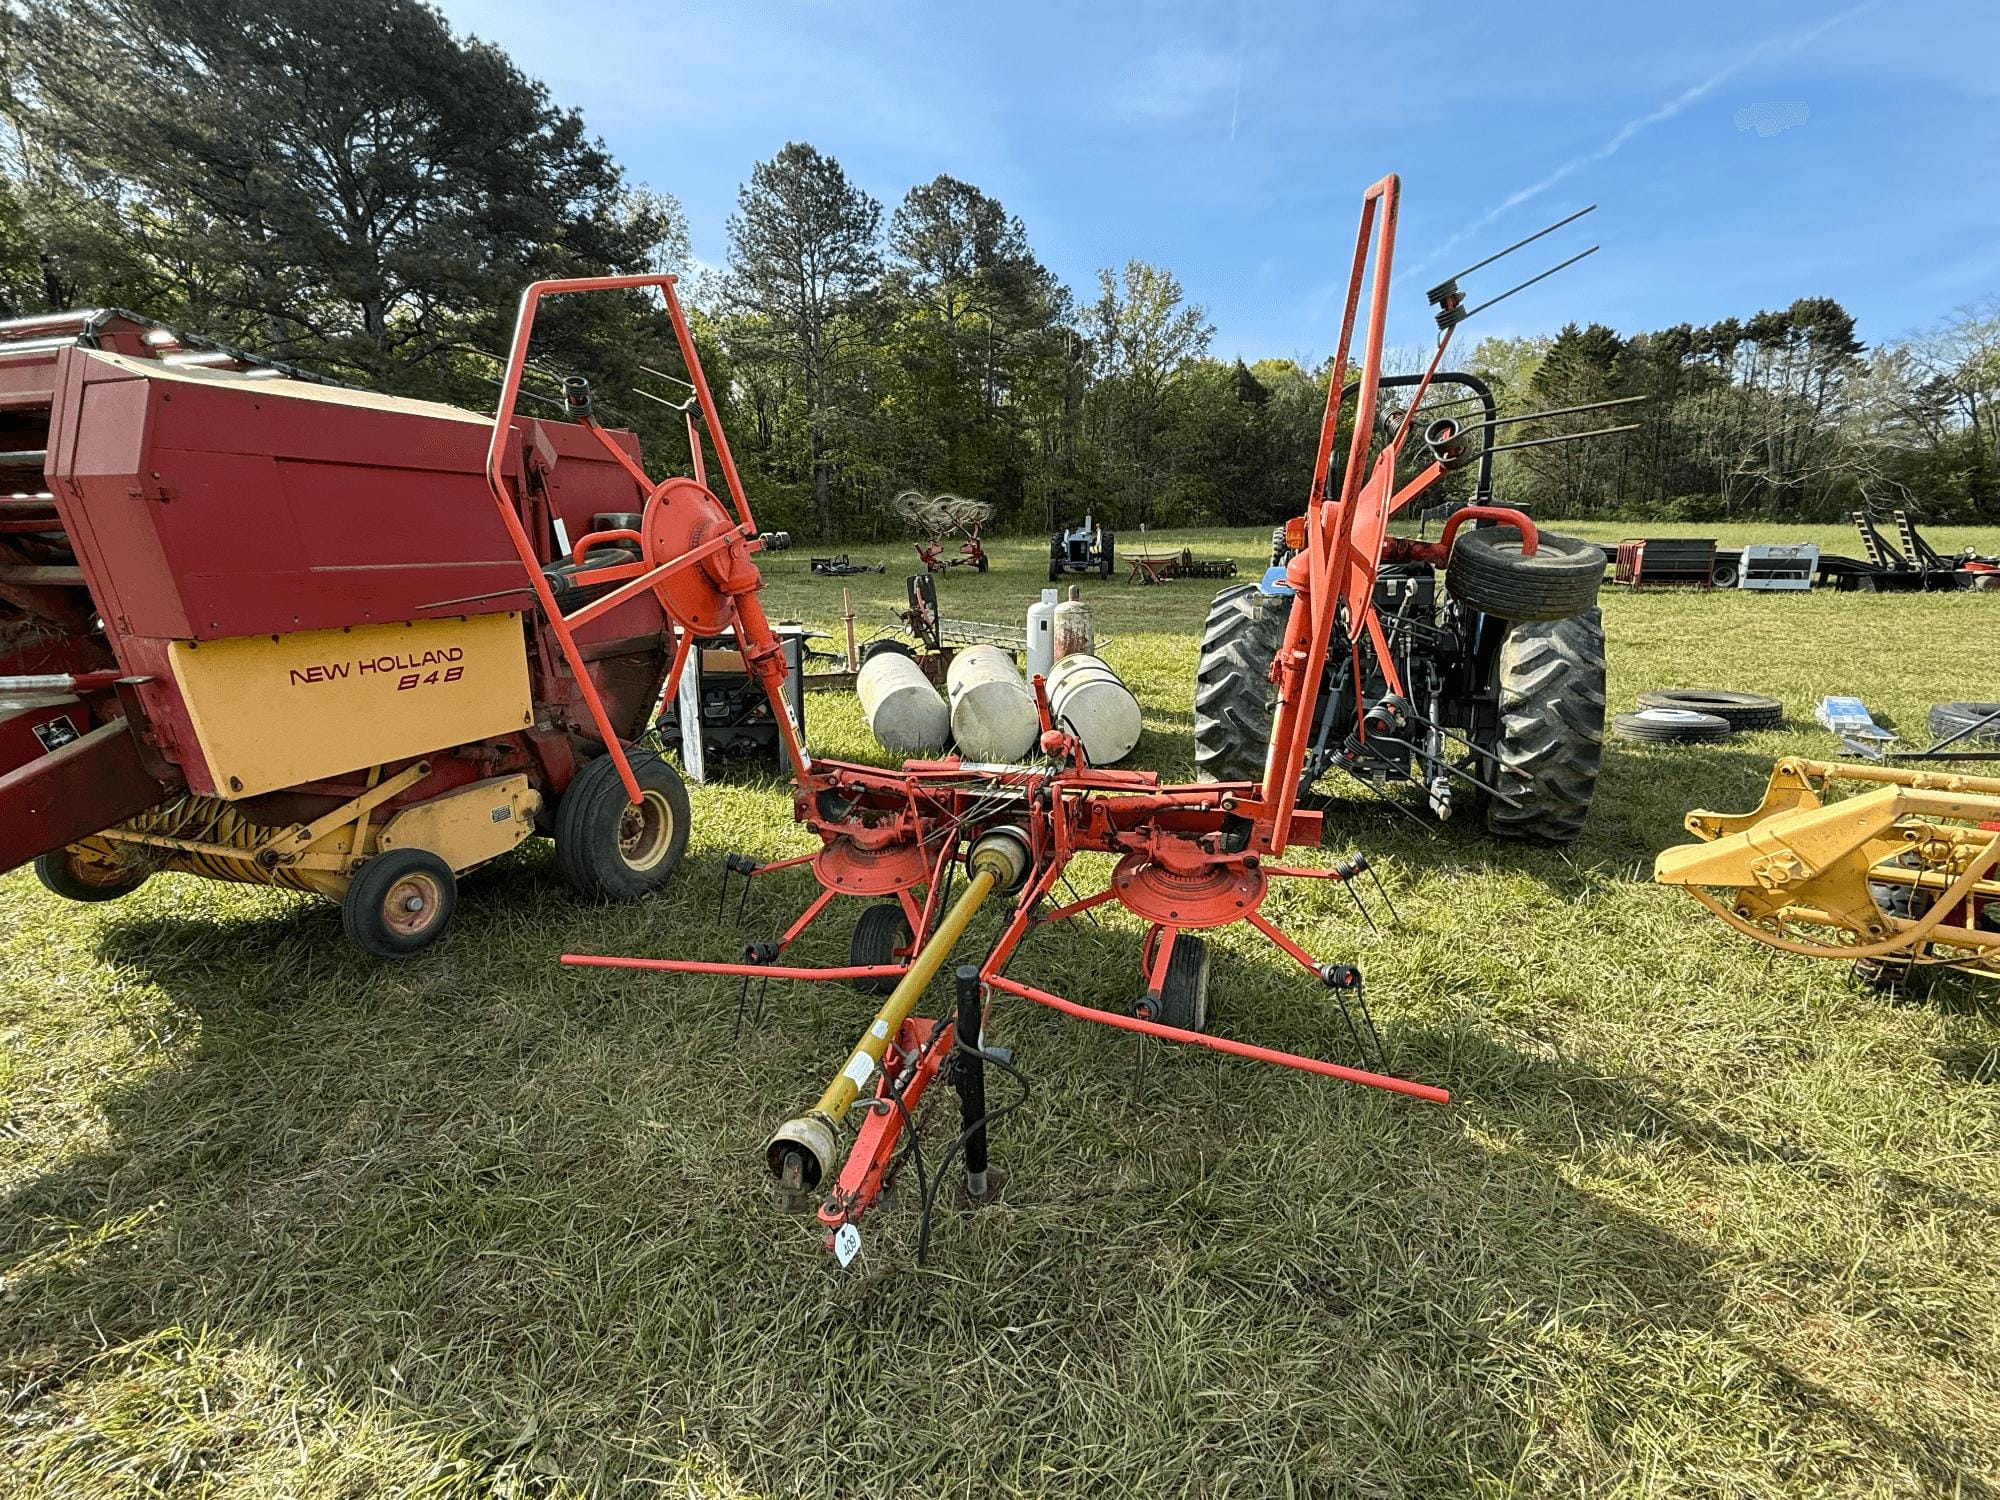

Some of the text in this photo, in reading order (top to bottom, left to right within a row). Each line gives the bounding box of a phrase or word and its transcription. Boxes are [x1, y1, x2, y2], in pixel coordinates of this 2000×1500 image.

[290, 647, 463, 686] NEW HOLLAND
[397, 666, 464, 691] 848
